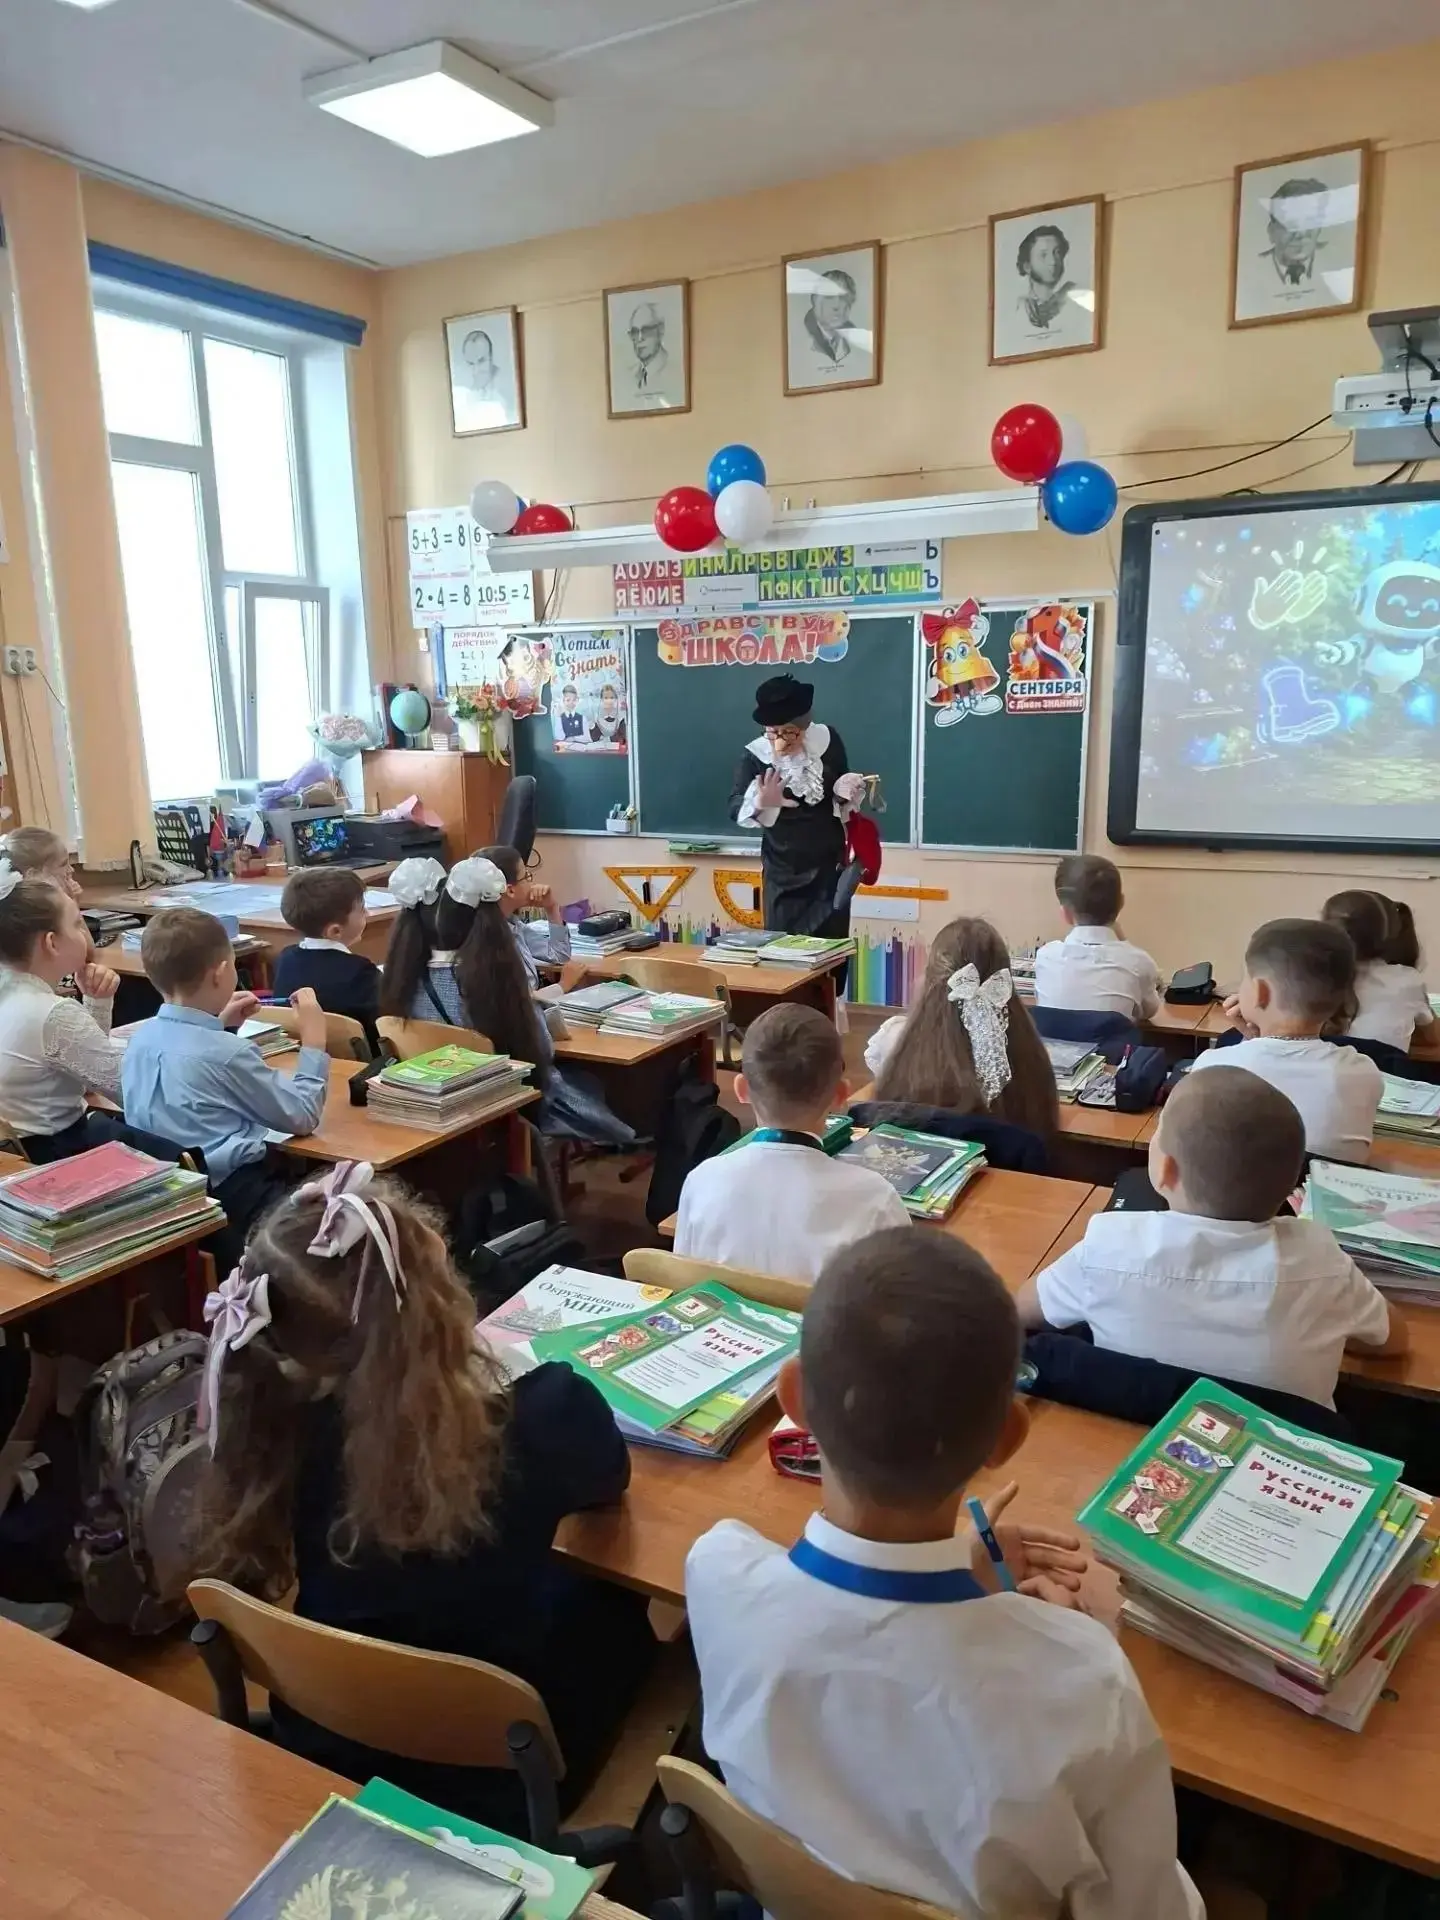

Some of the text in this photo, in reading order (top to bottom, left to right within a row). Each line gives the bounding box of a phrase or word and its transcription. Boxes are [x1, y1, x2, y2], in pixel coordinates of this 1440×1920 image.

[458, 525, 466, 547] 8
[474, 527, 481, 543] 6
[415, 587, 424, 608] 2
[437, 586, 444, 607] 4
[463, 584, 471, 606] 8
[478, 586, 506, 603] 10:5
[523, 584, 530, 600] 2
[557, 635, 611, 651] Хотим
[686, 632, 817, 665] ШКОЛА!
[1010, 681, 1081, 695] СЕНТЯБРЯ
[539, 1281, 636, 1310] Окружающий
[561, 1297, 612, 1314] МИР
[702, 1341, 739, 1358] язык
[705, 1327, 764, 1356] Русский
[1201, 1418, 1217, 1430] 3
[1249, 1460, 1355, 1509] Русский
[1259, 1484, 1325, 1514] язык
